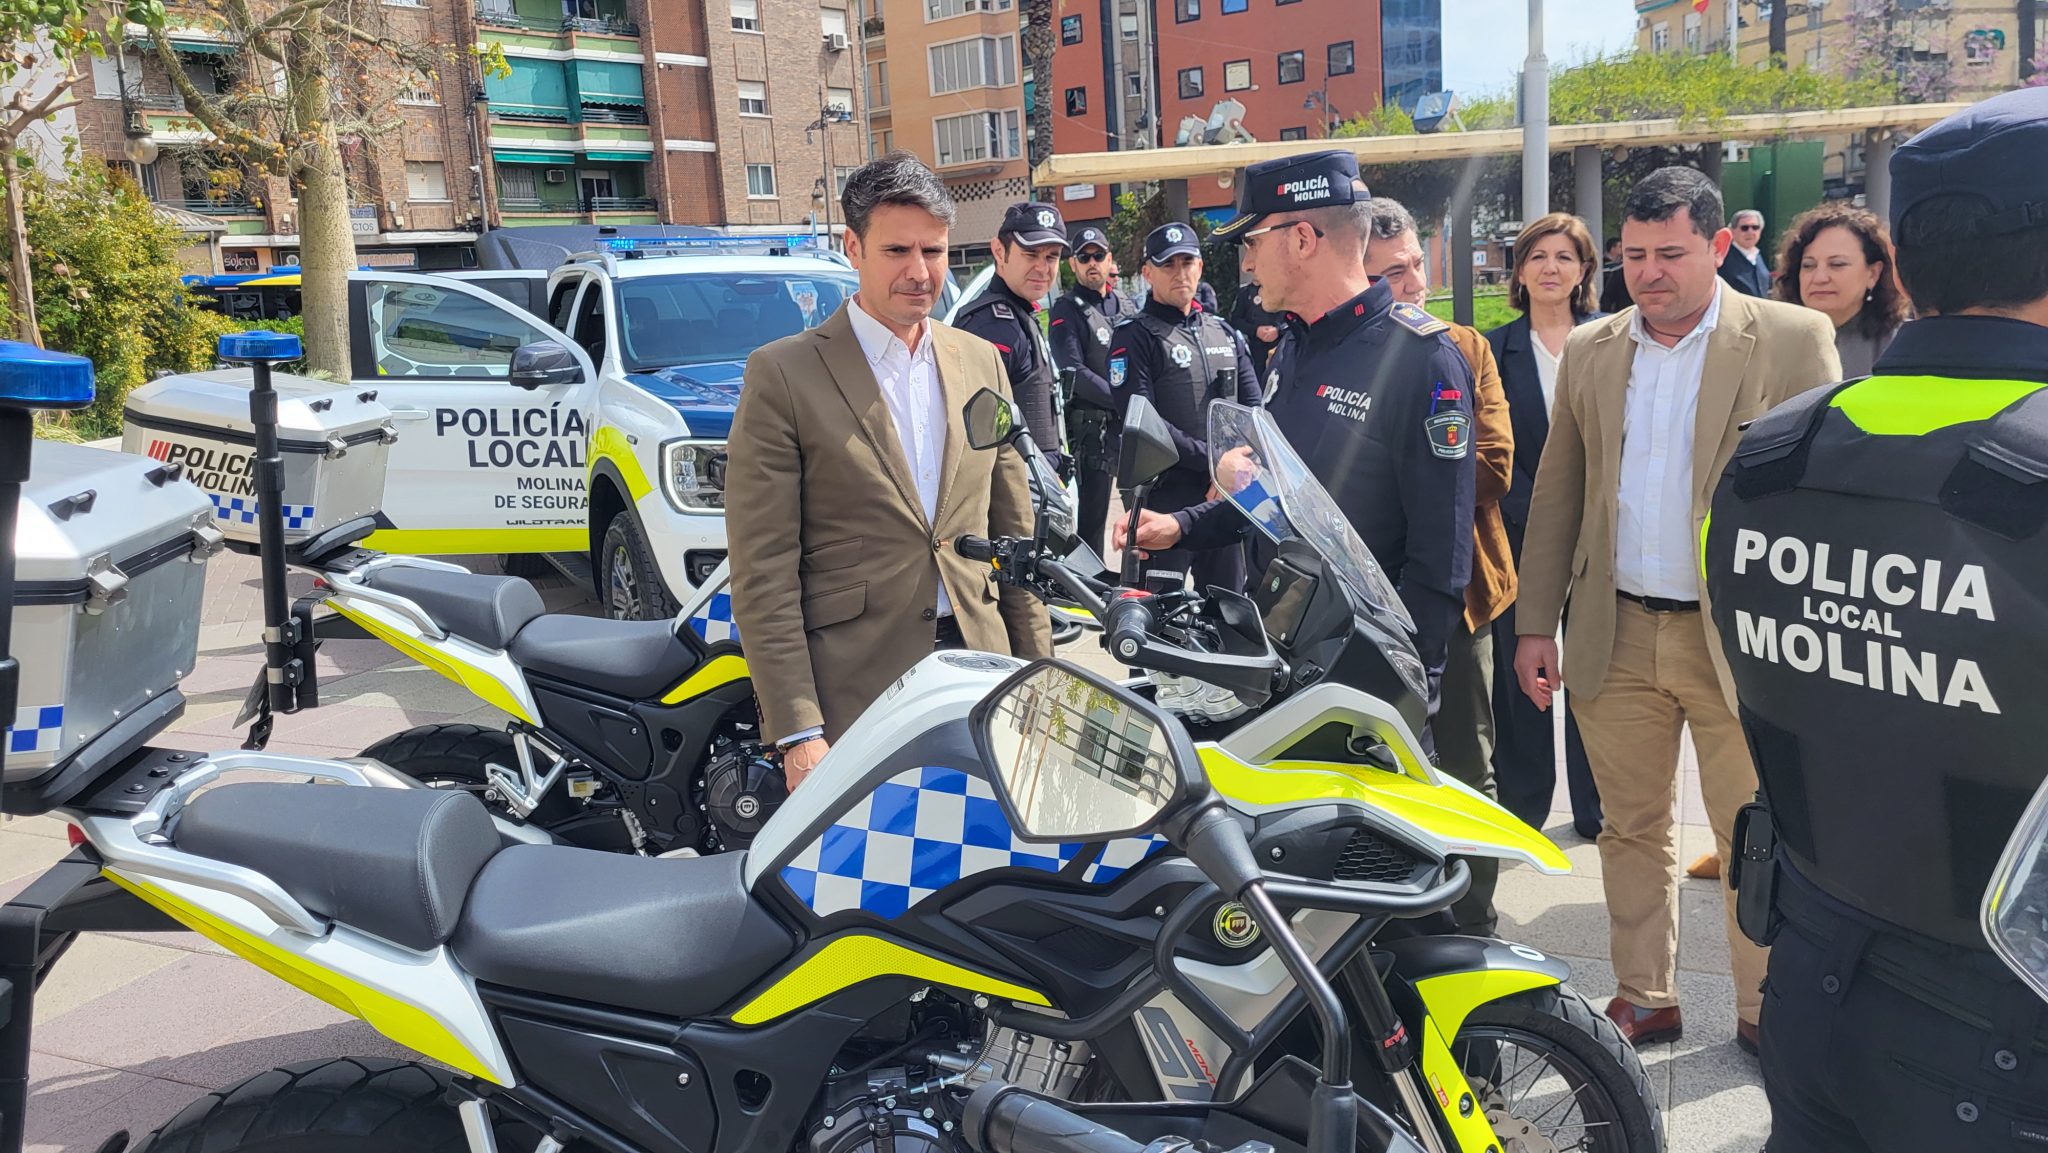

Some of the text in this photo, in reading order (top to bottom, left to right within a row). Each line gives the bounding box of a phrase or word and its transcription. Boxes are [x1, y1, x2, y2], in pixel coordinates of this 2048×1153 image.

[1284, 175, 1329, 194] POLICÍA
[1294, 189, 1331, 202] MOLINA
[351, 223, 374, 231] CTOS
[1322, 385, 1372, 410] POLICÍA
[436, 401, 585, 437] POLICÍA
[1327, 401, 1366, 422] MOLINA
[166, 443, 256, 477] POLICÍ
[468, 439, 585, 468] LOCAL
[186, 469, 257, 496] MOLIN
[517, 477, 587, 491] MOLINA
[494, 495, 588, 509] DE SEGURA
[1733, 528, 1996, 621] POLICIA
[1803, 596, 1903, 638] LOCAL
[1735, 609, 2002, 715] MOLINA
